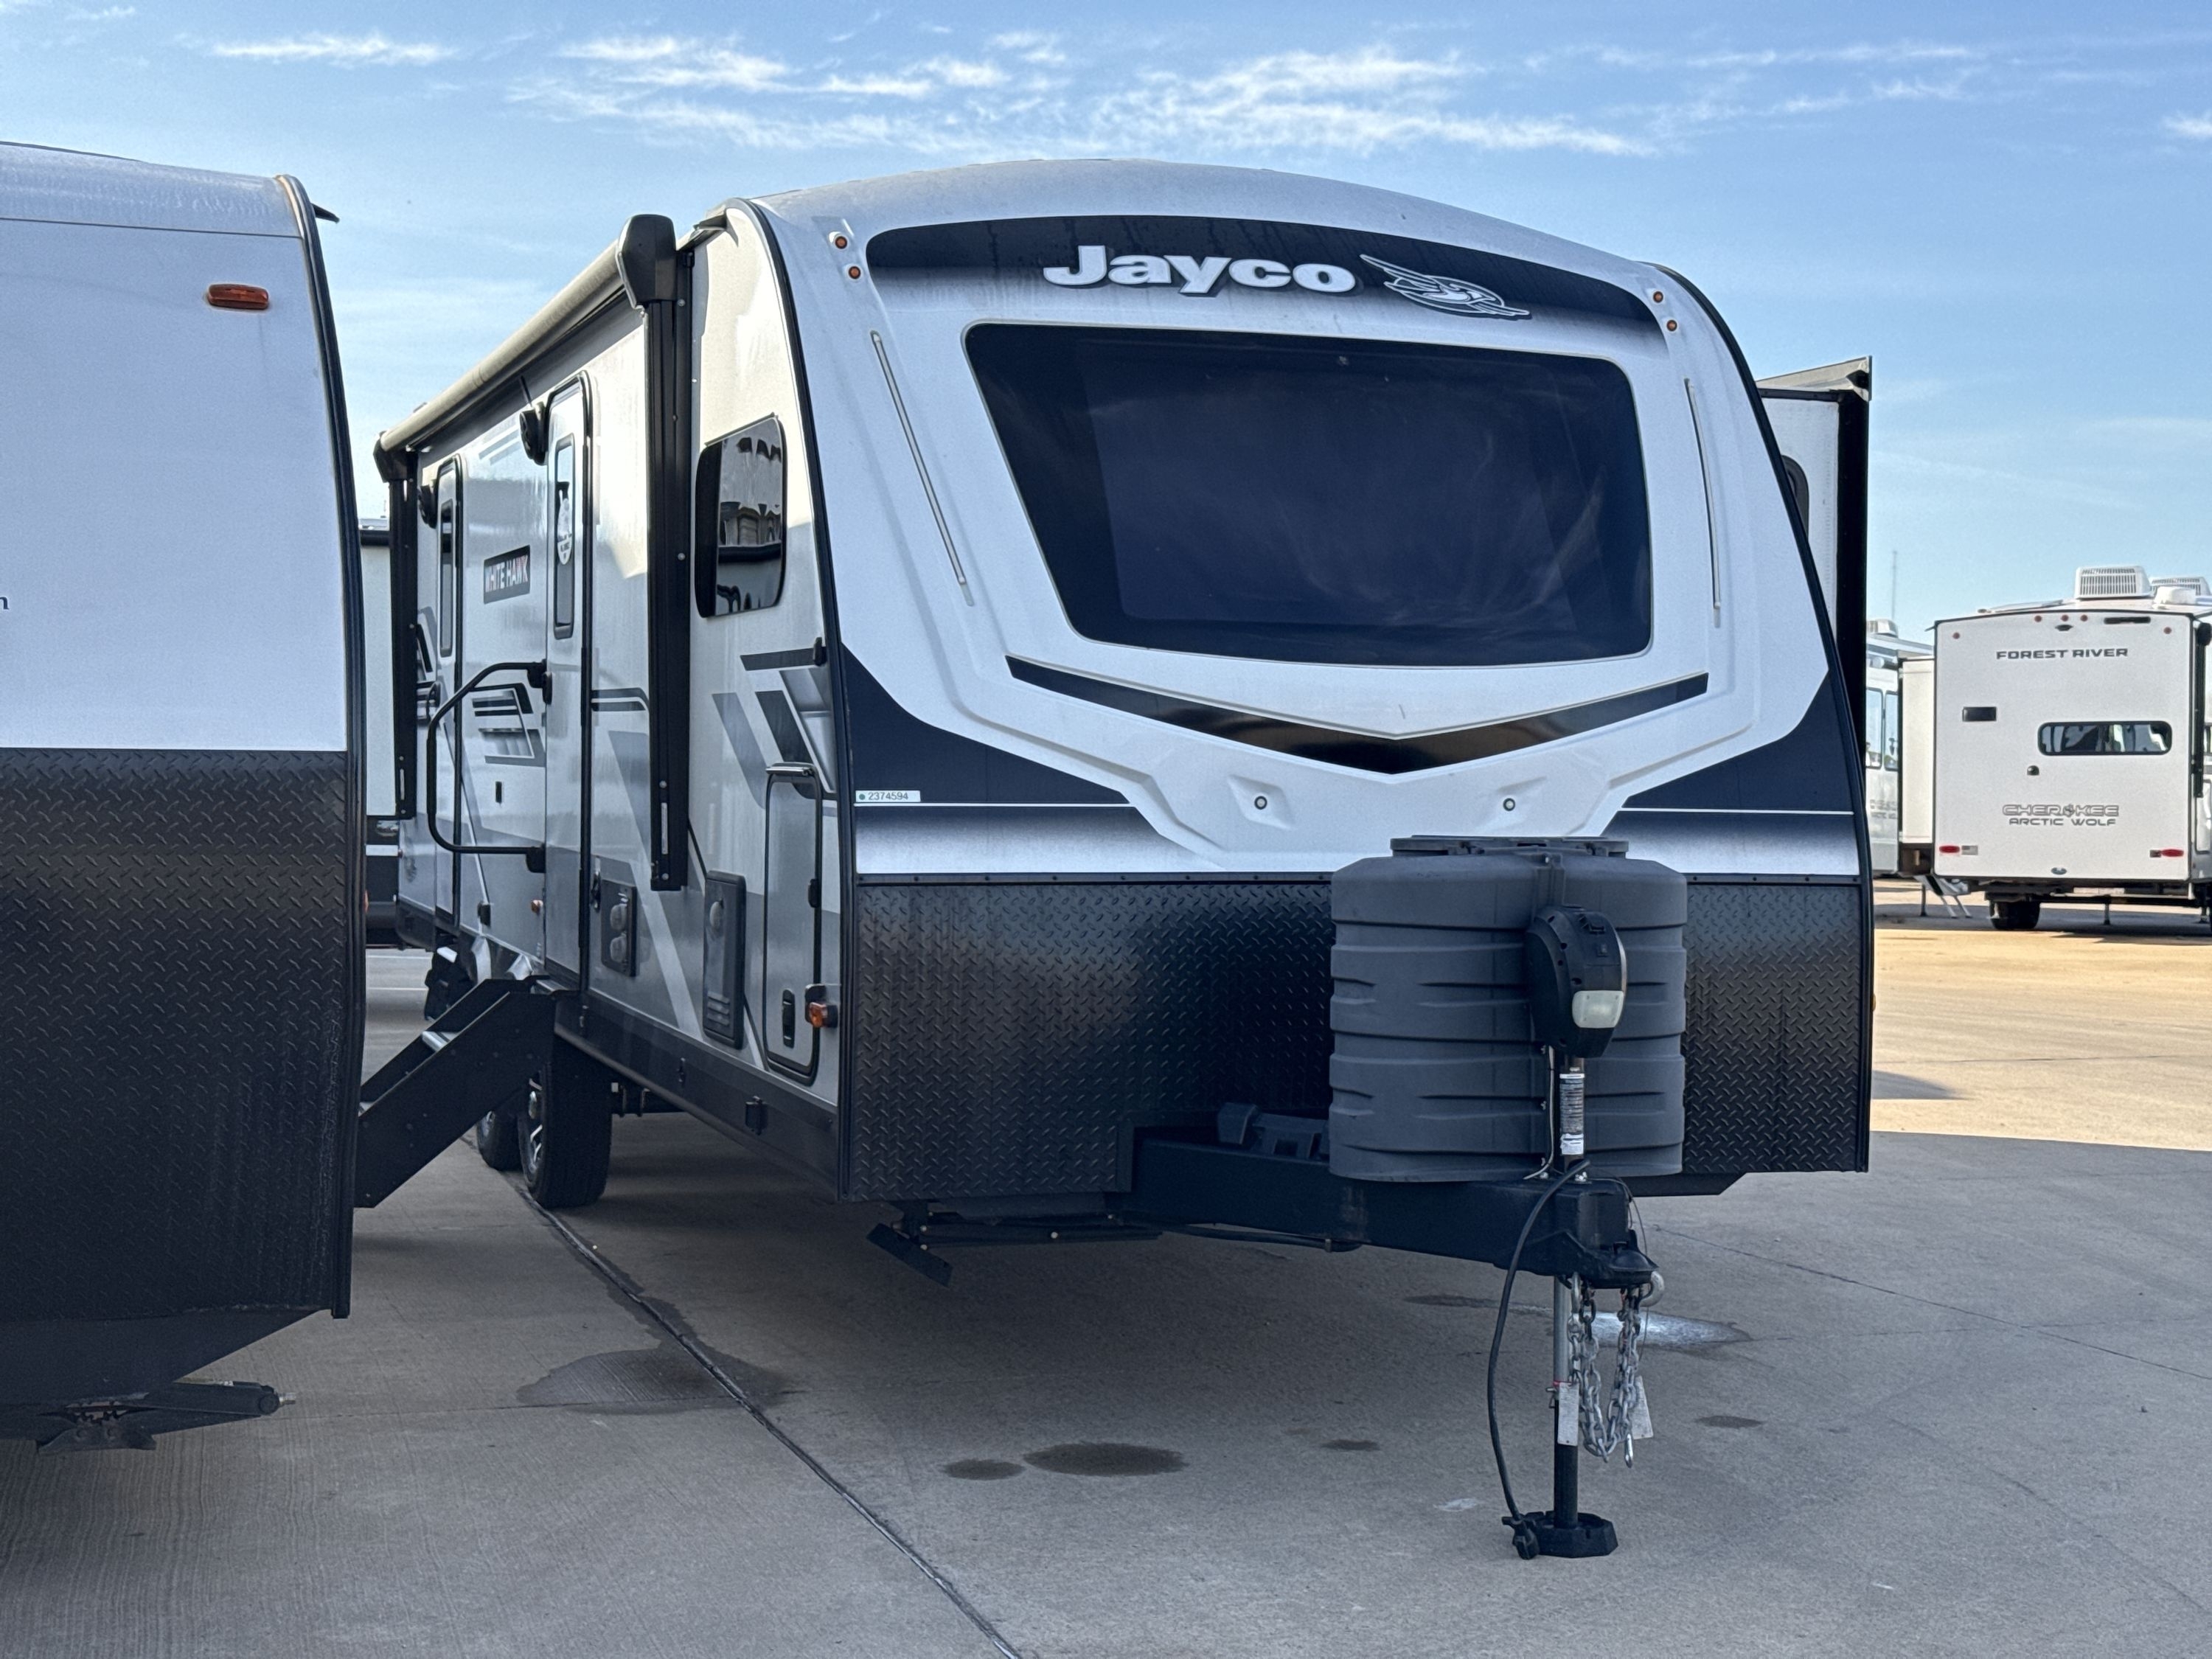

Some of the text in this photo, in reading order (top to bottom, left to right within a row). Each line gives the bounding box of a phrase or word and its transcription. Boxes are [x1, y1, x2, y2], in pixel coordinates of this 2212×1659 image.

[1042, 245, 1357, 295] Jayco
[506, 554, 529, 588] HAWK
[1996, 648, 2129, 659] FOREST RIVER
[868, 791, 909, 801] 2374594
[2008, 818, 2117, 827] ARCTIC WOLF
